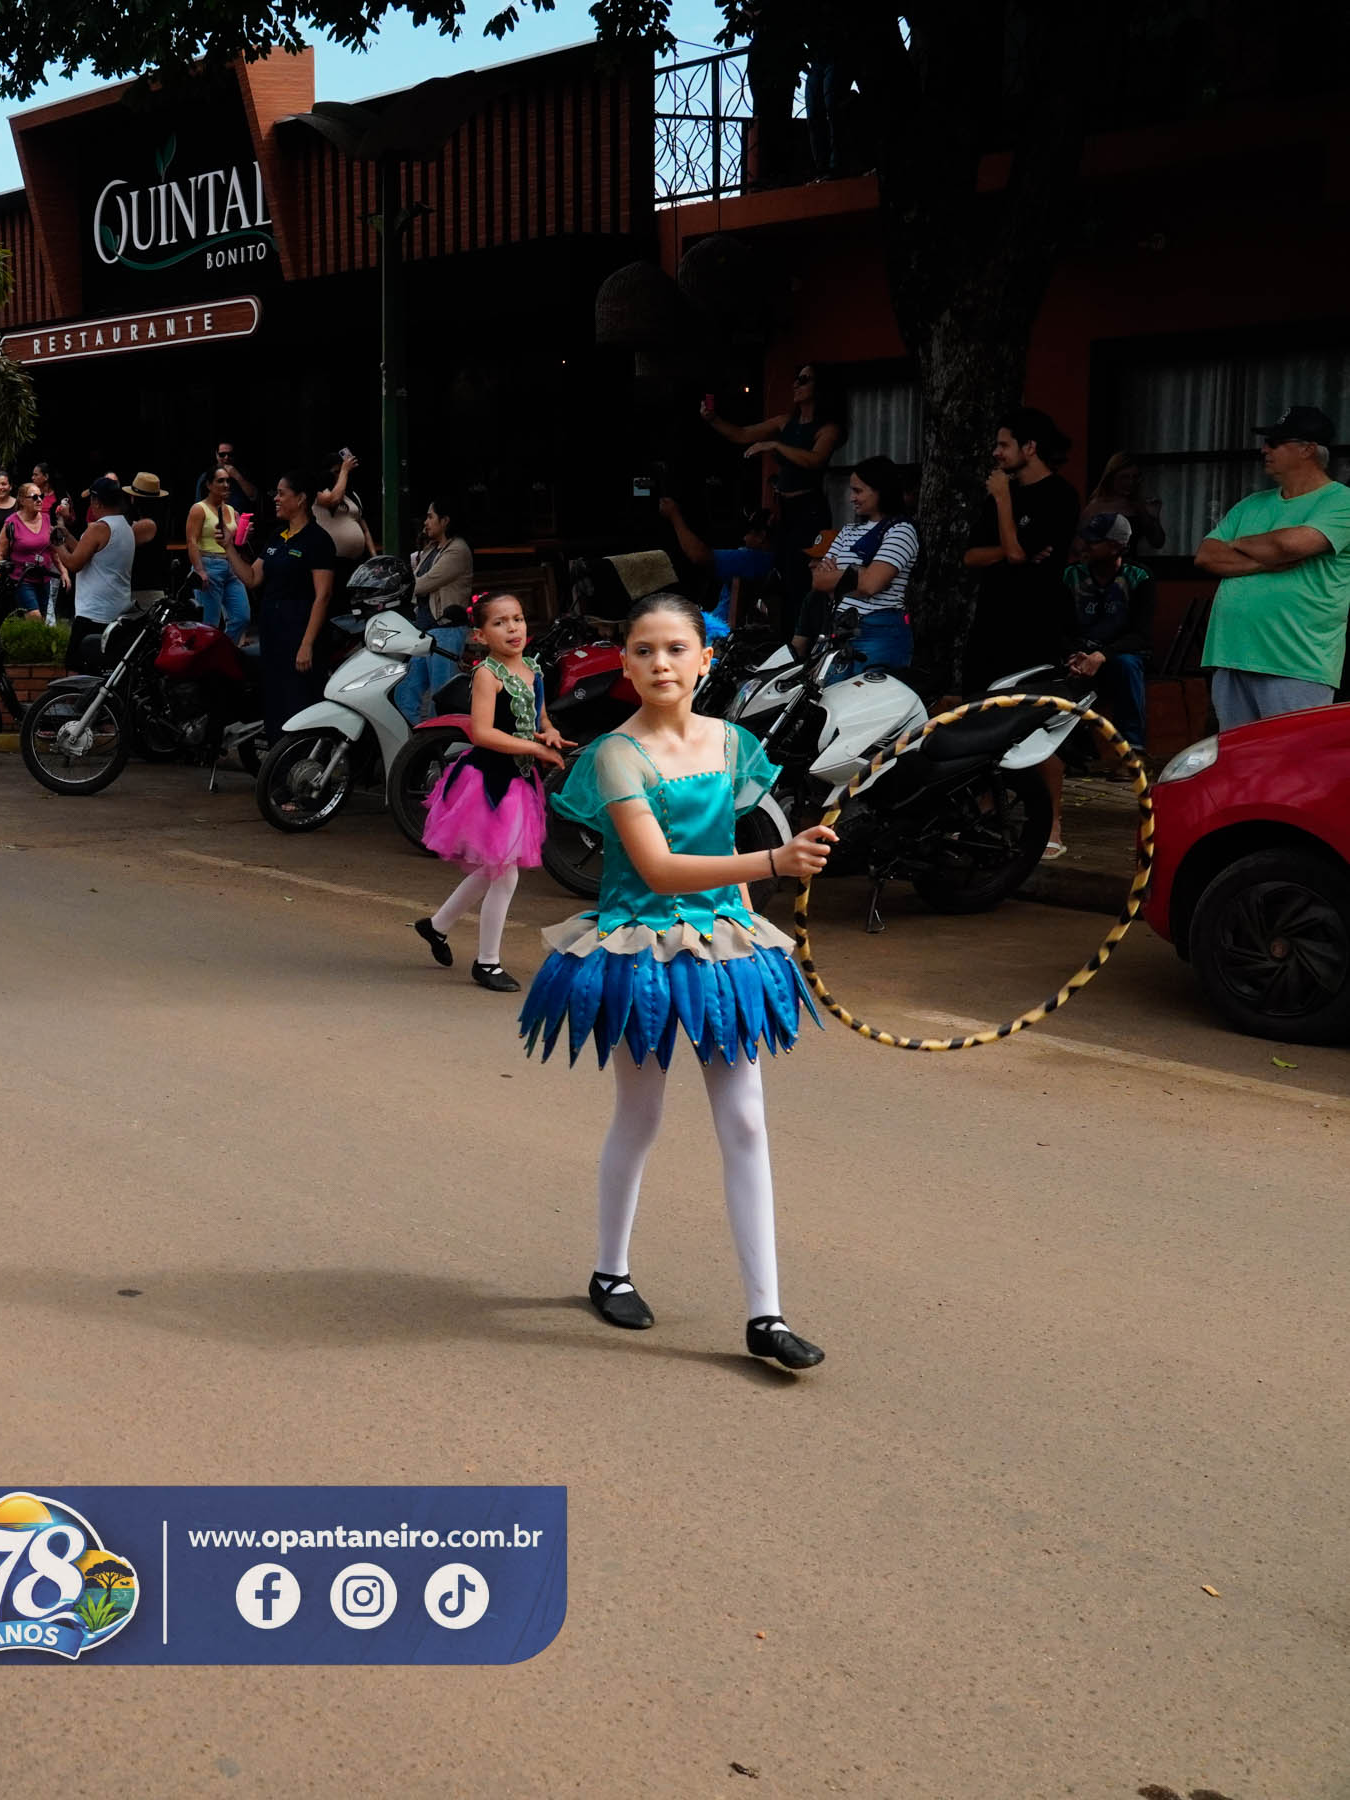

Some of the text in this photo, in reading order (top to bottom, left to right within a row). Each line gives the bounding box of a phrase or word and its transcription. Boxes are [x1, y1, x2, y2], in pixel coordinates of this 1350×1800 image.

[93, 161, 272, 265] QUINTAL
[206, 242, 267, 269] BONITO
[33, 313, 212, 354] RESTAURANTE
